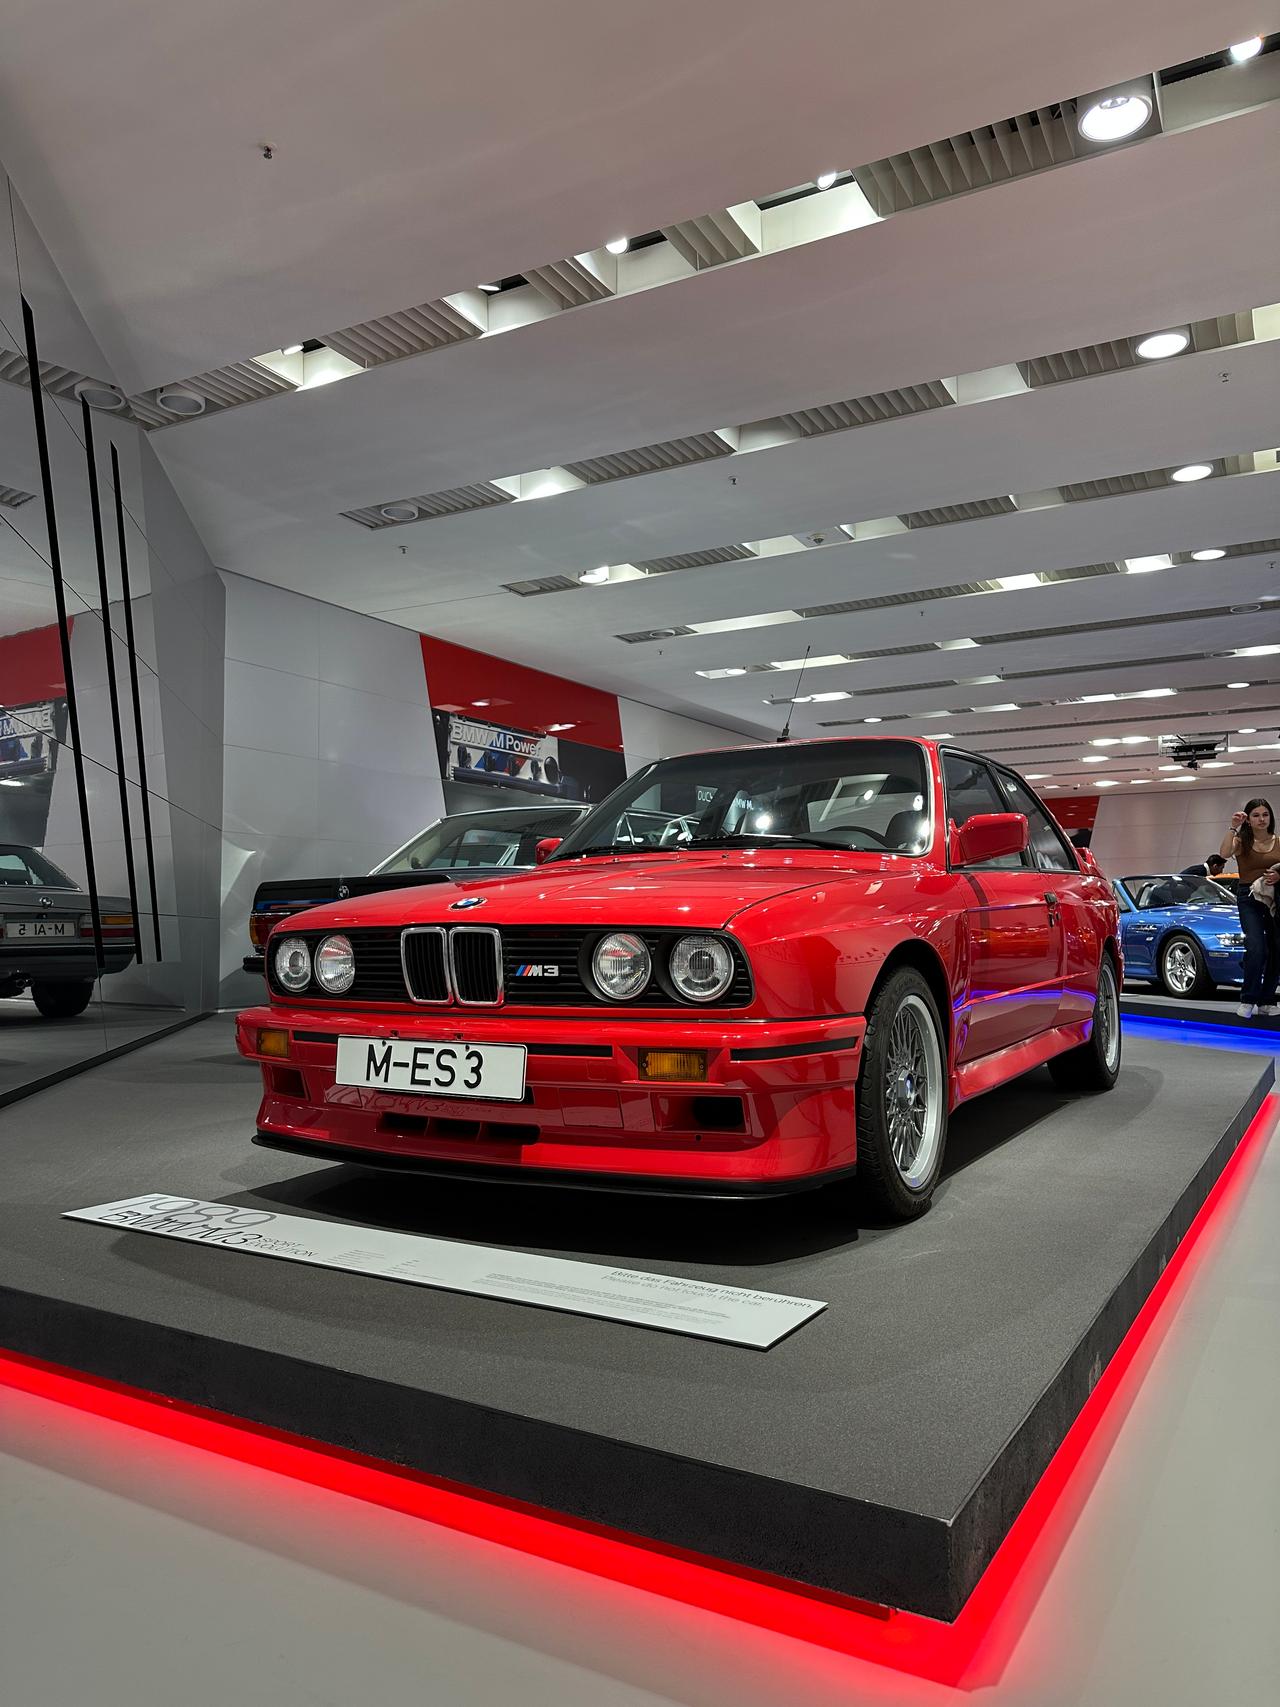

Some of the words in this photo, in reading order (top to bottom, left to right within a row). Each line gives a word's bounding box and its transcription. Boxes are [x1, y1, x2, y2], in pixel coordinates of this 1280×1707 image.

[452, 724, 489, 746] BMW
[493, 734, 504, 749] M
[506, 735, 541, 757] Power
[527, 964, 559, 977] M3
[366, 1043, 458, 1088] M-ES
[463, 1050, 484, 1089] 3
[98, 1210, 207, 1233] BMW
[188, 1226, 263, 1245] M3
[108, 1196, 277, 1230] 1989
[611, 1270, 640, 1279] Bitte
[663, 1279, 719, 1293] Fahrzeug
[720, 1289, 752, 1298] nicht
